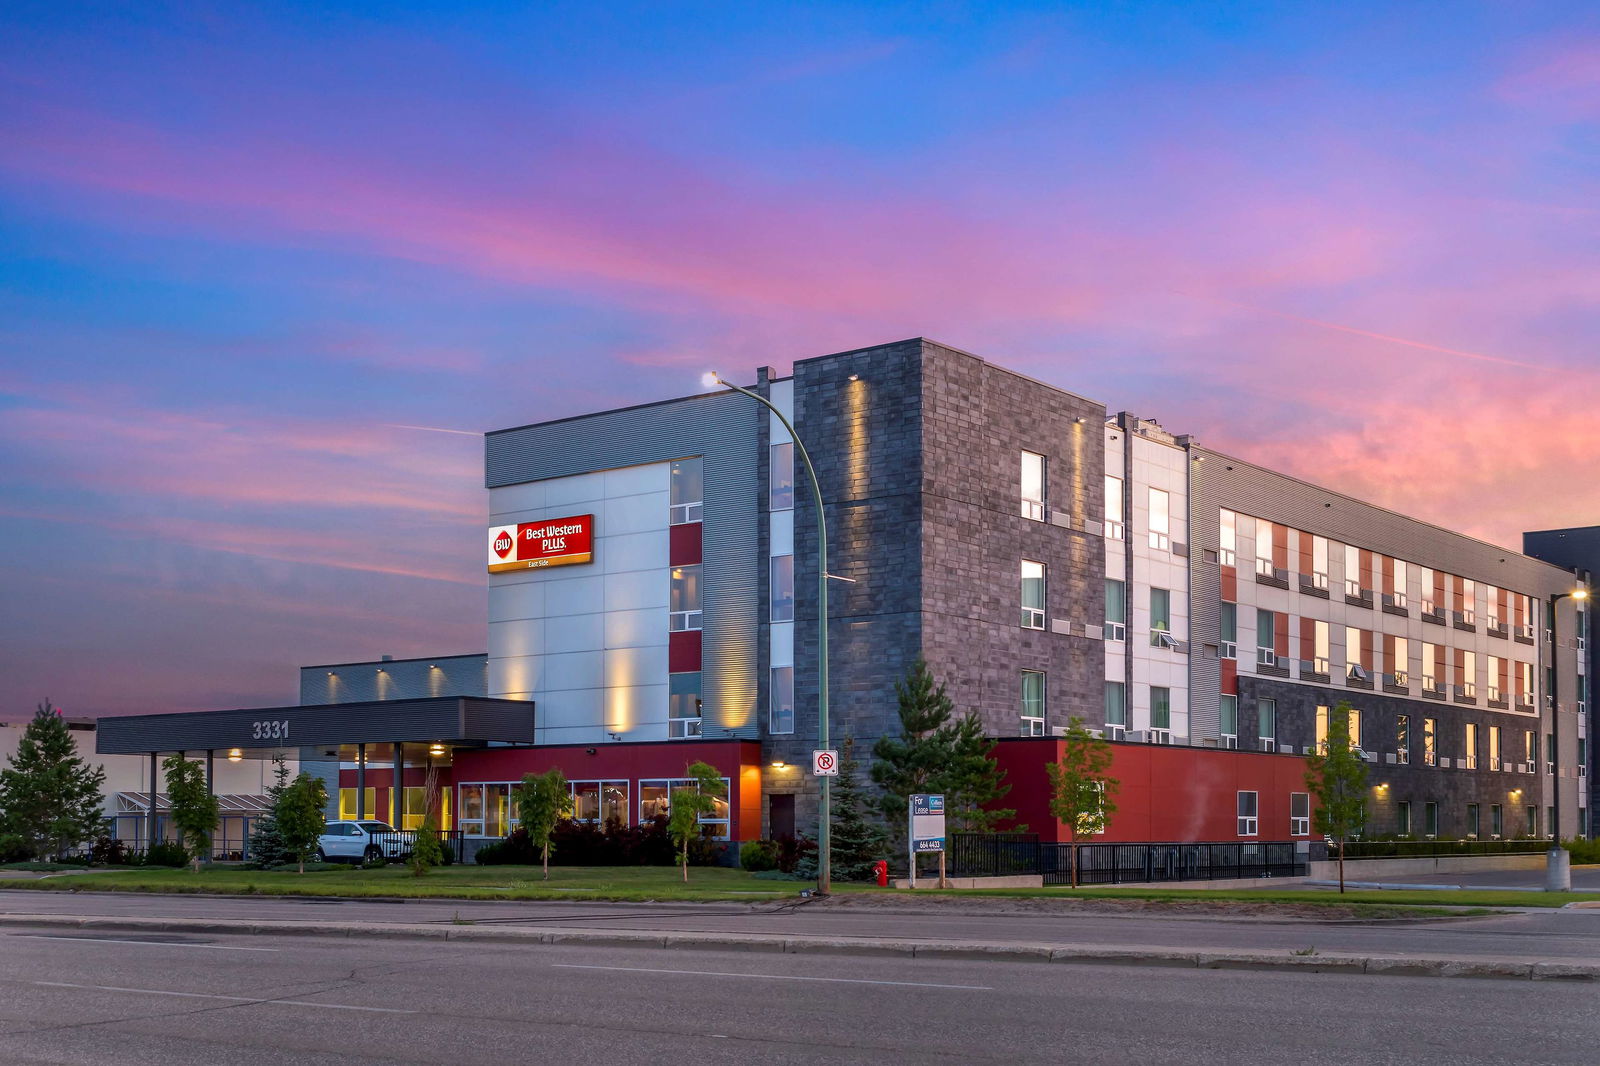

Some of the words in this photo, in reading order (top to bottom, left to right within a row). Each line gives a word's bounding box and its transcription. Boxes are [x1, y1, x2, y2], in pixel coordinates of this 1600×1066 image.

[526, 528, 545, 540] Best
[546, 524, 582, 537] Western
[495, 538, 510, 550] BW
[542, 537, 565, 551] PLUS
[528, 560, 538, 568] East
[538, 559, 549, 567] Side
[253, 720, 288, 739] 3331
[915, 796, 923, 805] For
[915, 806, 928, 814] Lease
